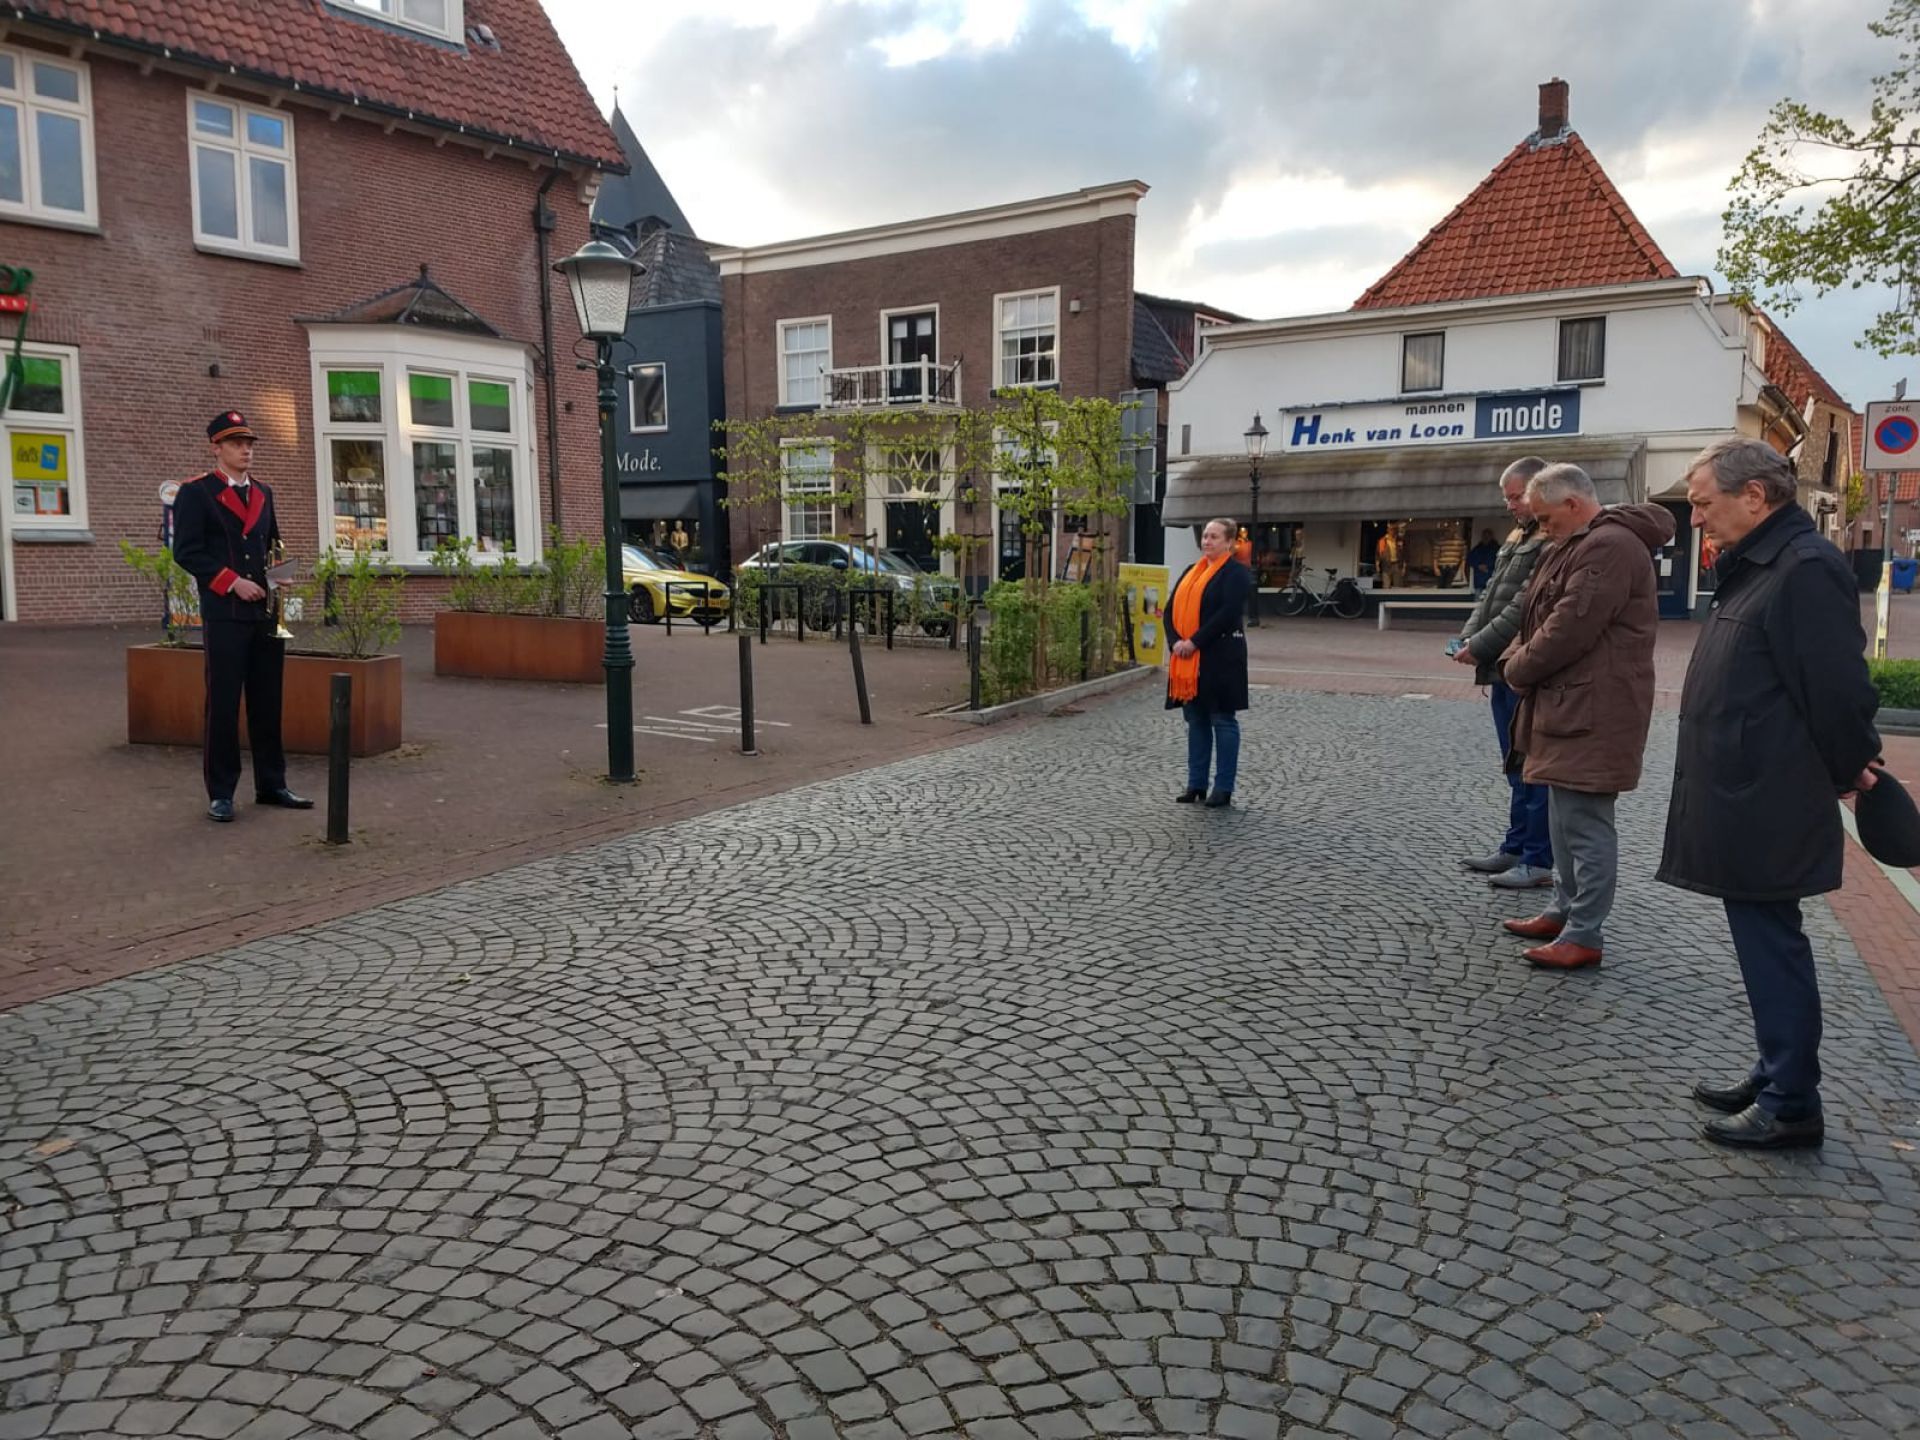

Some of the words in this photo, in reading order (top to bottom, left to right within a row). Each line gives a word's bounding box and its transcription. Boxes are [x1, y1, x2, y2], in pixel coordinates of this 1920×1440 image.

[1404, 401, 1466, 416] mannen
[1490, 398, 1563, 433] mode
[1885, 404, 1911, 413] ZONE
[1290, 414, 1356, 446] Henk
[1366, 428, 1402, 440] van
[1409, 423, 1465, 438] Loon
